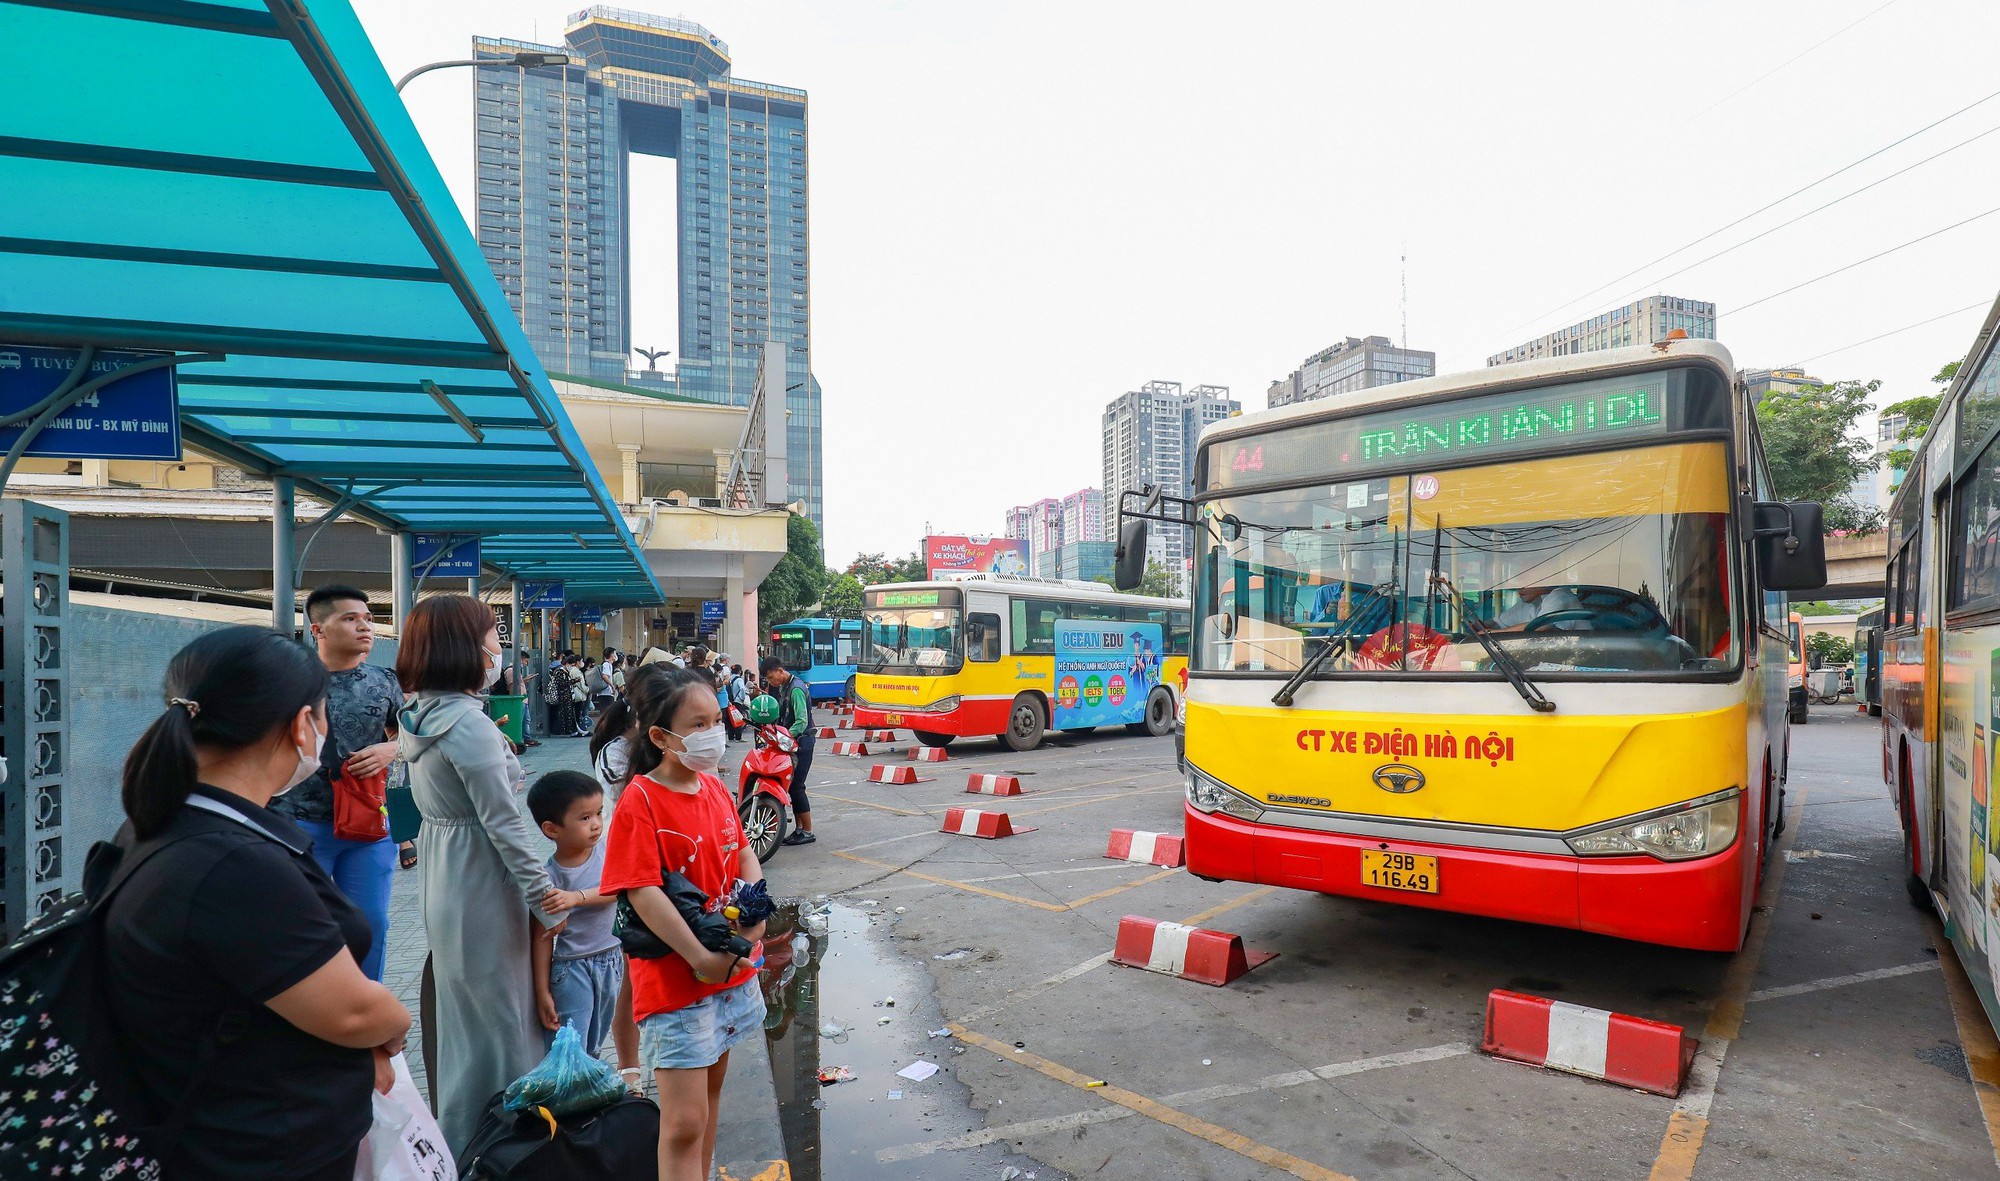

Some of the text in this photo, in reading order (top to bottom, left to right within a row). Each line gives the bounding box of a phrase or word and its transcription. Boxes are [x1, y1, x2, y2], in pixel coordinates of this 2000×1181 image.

[31, 356, 76, 371] TUYẾ
[75, 390, 100, 408] 4
[75, 417, 93, 431] DƯ
[103, 420, 118, 432] BX
[121, 418, 138, 432] MỸ
[141, 420, 169, 433] ĐÌNH
[1232, 444, 1264, 473] 44
[1415, 478, 1436, 496] 44
[943, 551, 966, 560] KHÁCH
[1062, 631, 1124, 649] OCEAN EDU
[931, 651, 944, 662] 87
[1086, 688, 1102, 696] IELTS
[1110, 687, 1124, 695] TOEIC
[1296, 727, 1514, 768] CT XE ĐIỆN HÀ NỘI
[1267, 792, 1332, 807] DAEWOO
[1382, 853, 1415, 871] 29B
[1371, 869, 1429, 890] 116.49
